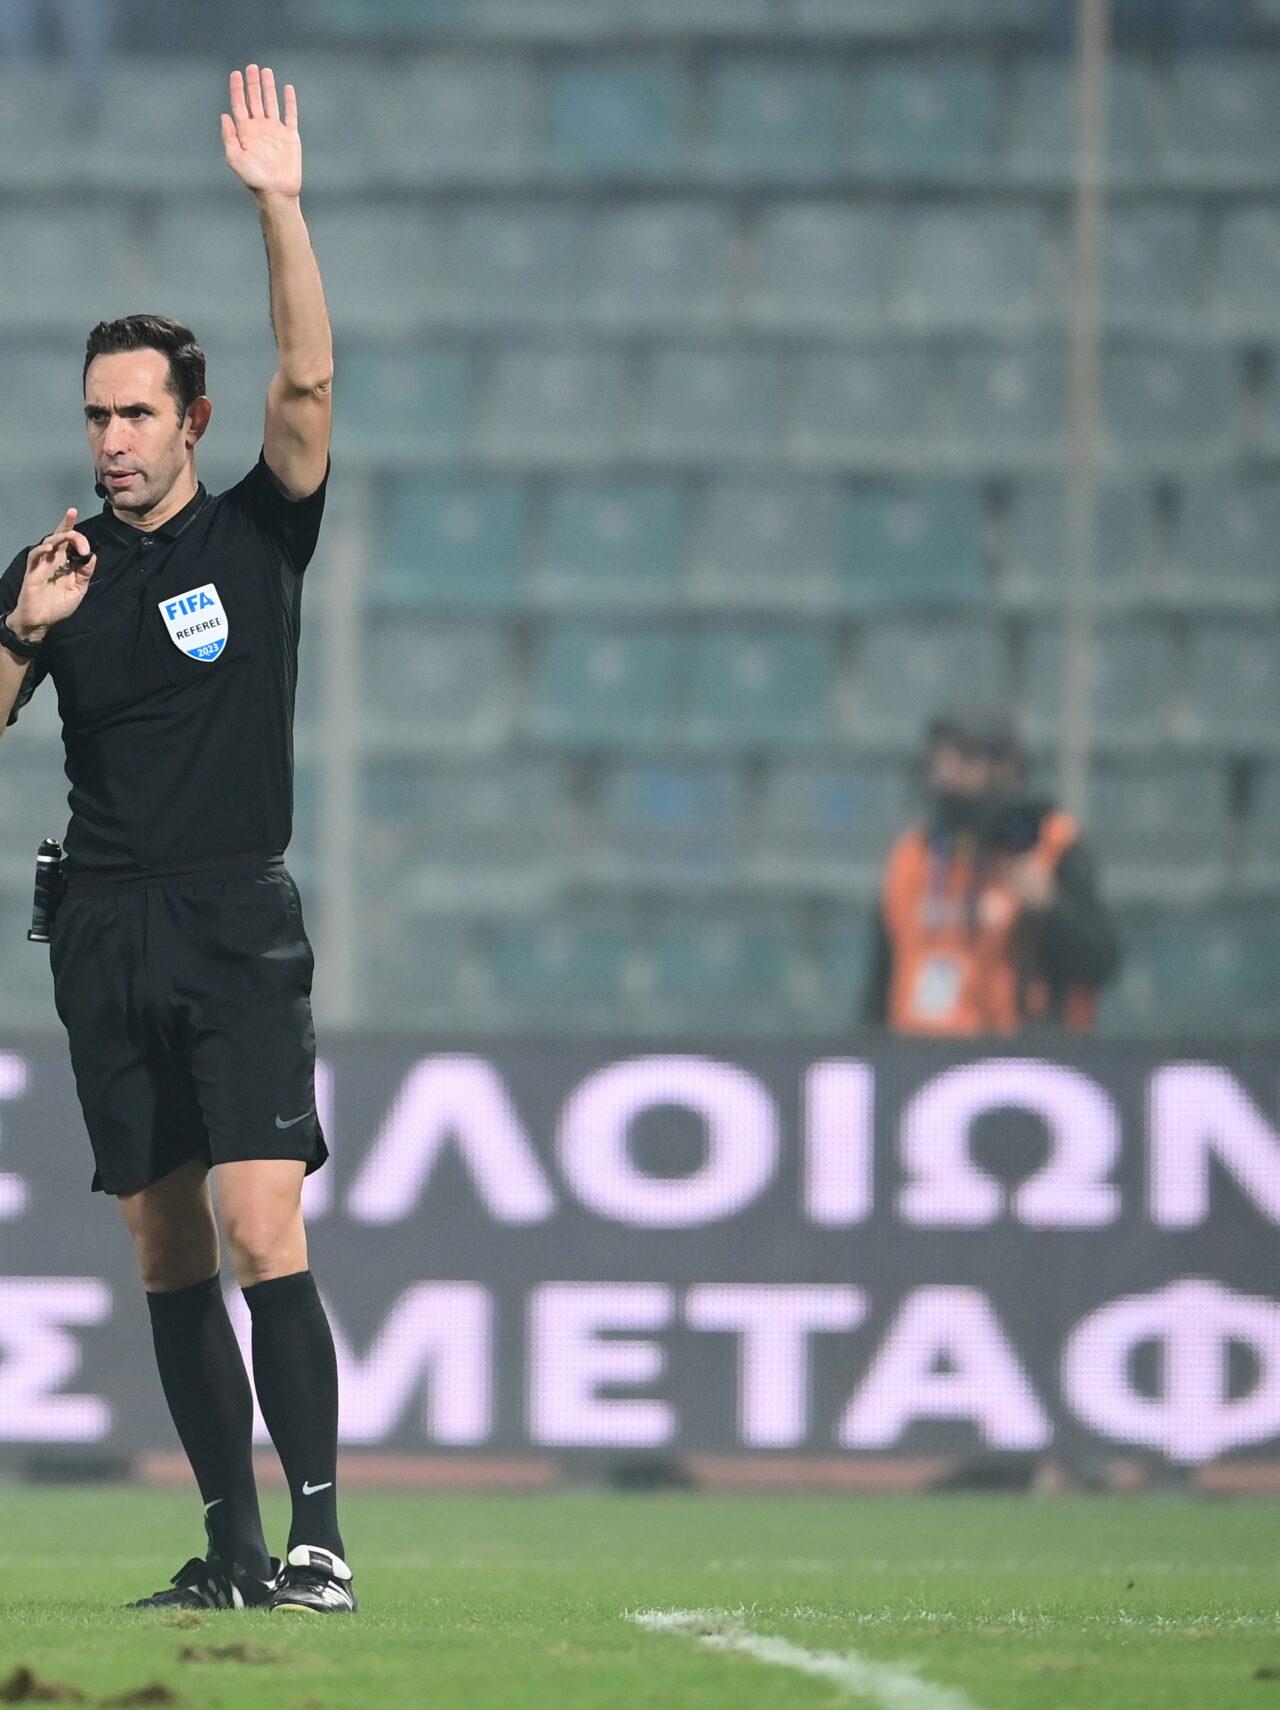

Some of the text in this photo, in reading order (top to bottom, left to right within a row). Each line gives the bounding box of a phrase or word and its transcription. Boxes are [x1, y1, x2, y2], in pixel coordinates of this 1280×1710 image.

[165, 592, 215, 620] FIFA
[197, 643, 219, 657] 2023
[300, 1050, 1280, 1230] ΛΟΙΩΝ
